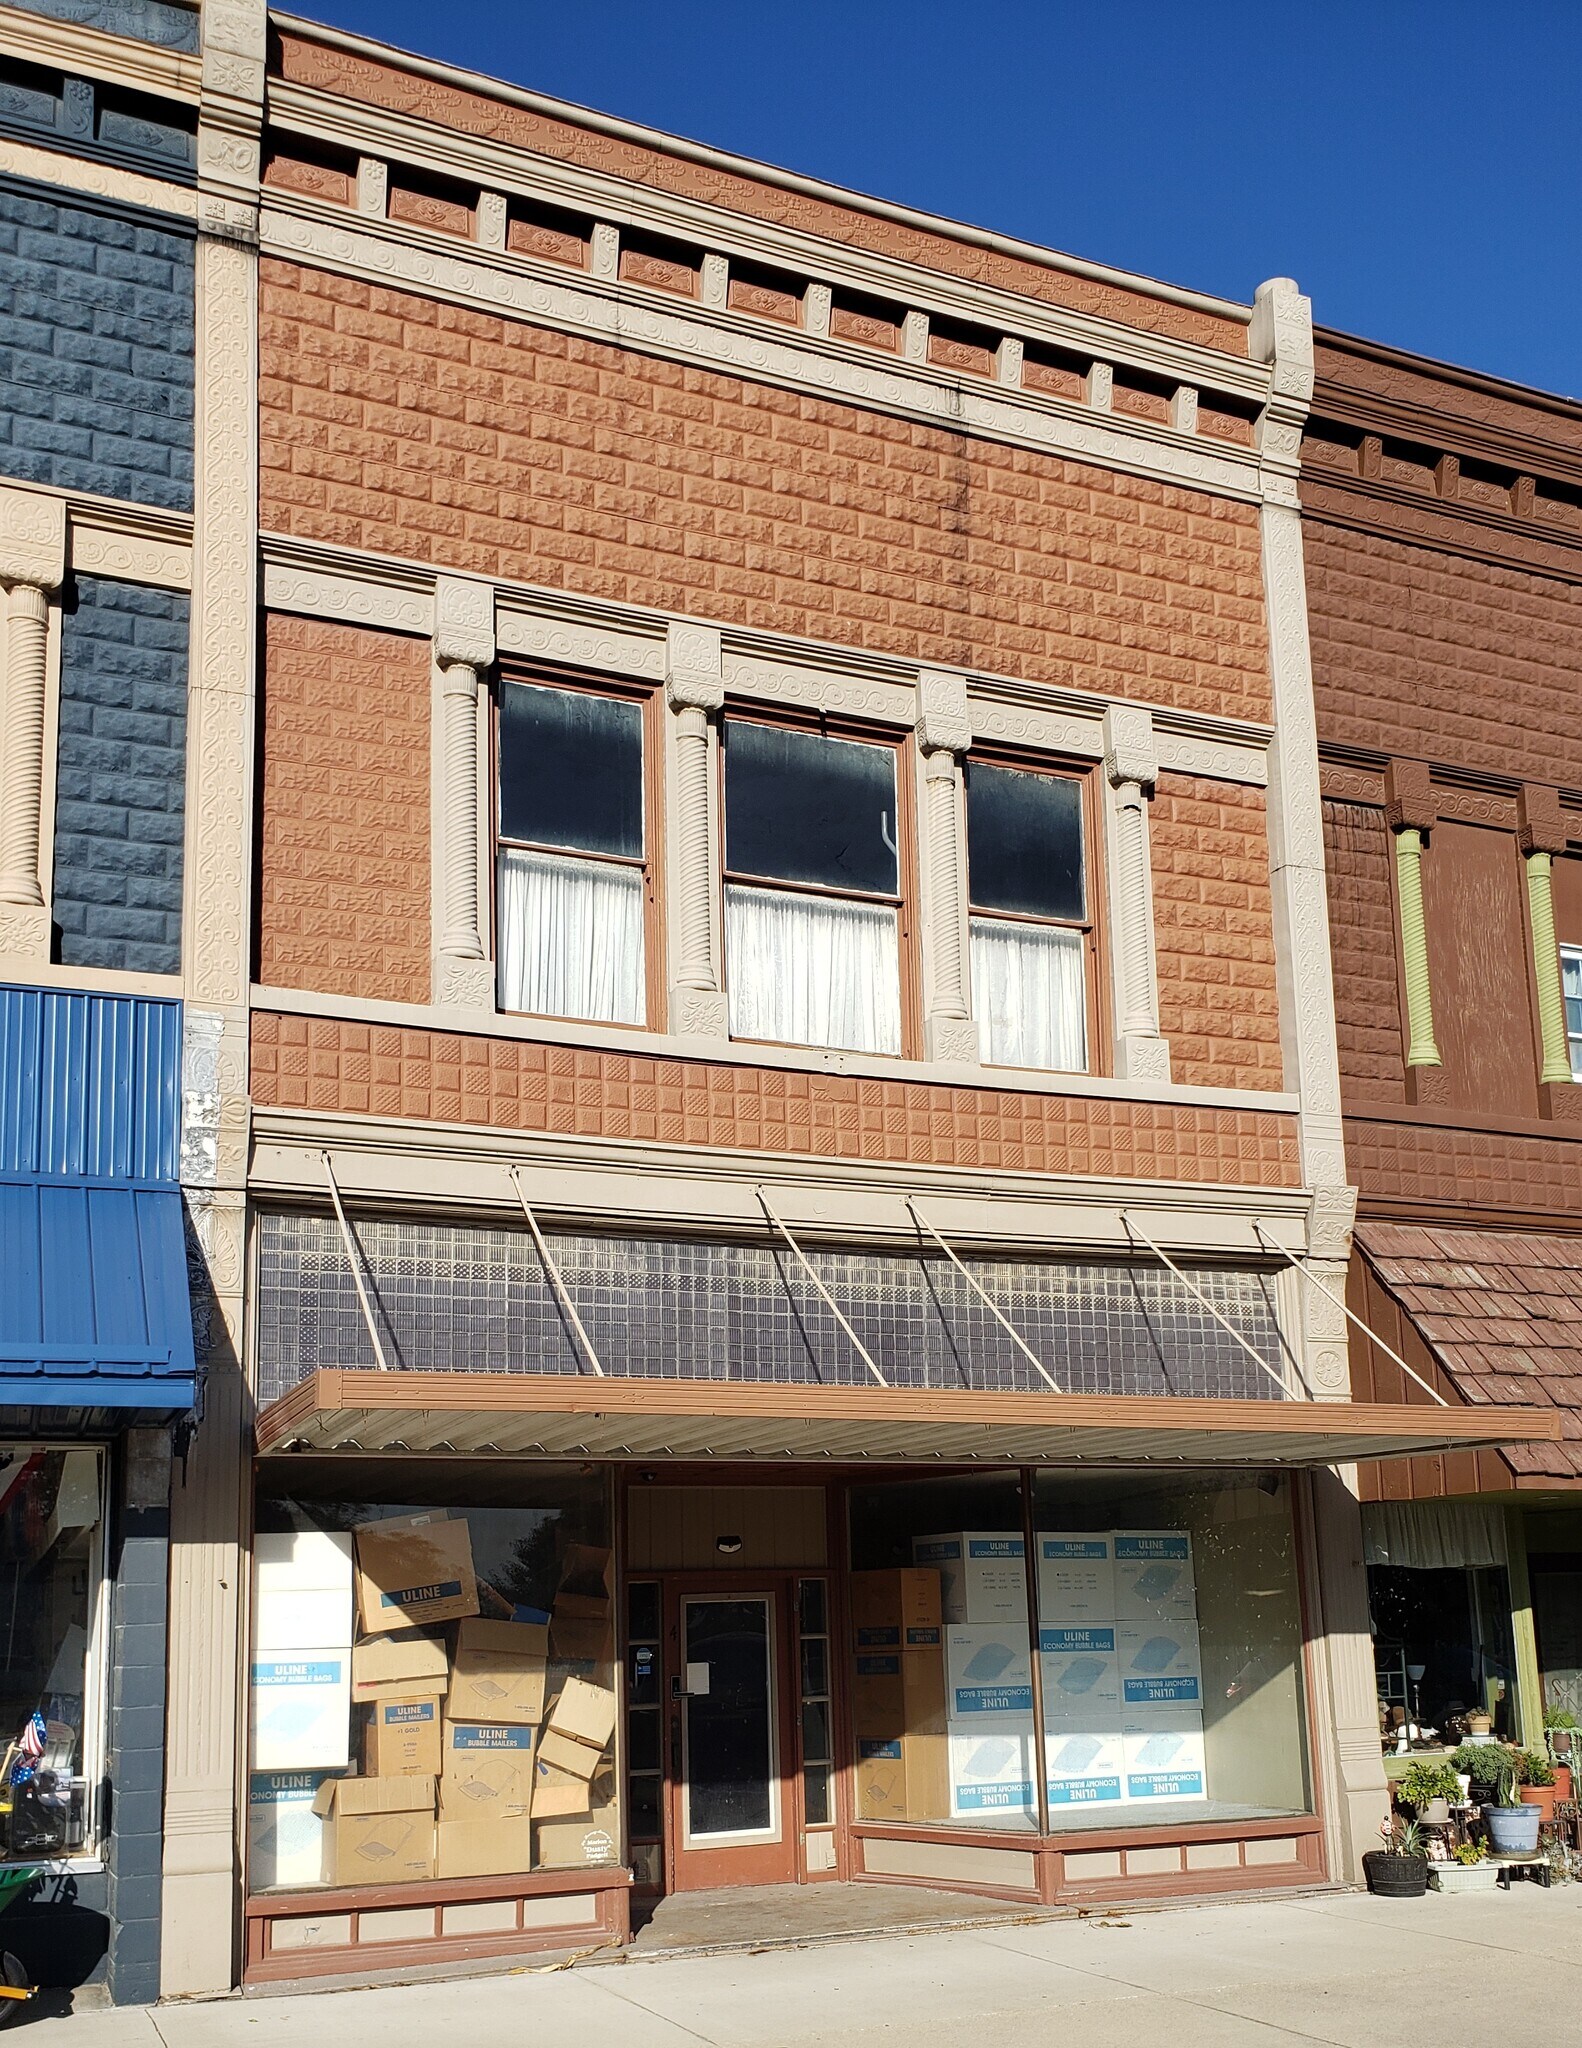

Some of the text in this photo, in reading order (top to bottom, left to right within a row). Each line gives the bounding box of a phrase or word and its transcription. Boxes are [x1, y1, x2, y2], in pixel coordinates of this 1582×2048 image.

[989, 1542, 1010, 1550] ULINE
[1064, 1543, 1086, 1551] ULINE
[1138, 1540, 1164, 1549] ULINE
[1117, 1549, 1148, 1557] ECONOMY
[1169, 1550, 1185, 1558] BAGS
[402, 1586, 441, 1602] ULINE
[1064, 1631, 1090, 1641] ULINE
[1043, 1642, 1074, 1650] ECONOMY
[1075, 1641, 1094, 1649] BUBBLE
[274, 1664, 308, 1675] ULINE
[254, 1675, 288, 1683] CONOMY
[313, 1674, 333, 1682] BAGS
[1165, 1679, 1195, 1687] ECONOMY
[1144, 1680, 1163, 1688] BUBBLE
[959, 1690, 976, 1698] BAGS
[998, 1688, 1030, 1696] ECONOMY
[1149, 1688, 1175, 1698] ULINE
[981, 1698, 1009, 1708] ULINE
[397, 1705, 422, 1715] ULINE
[478, 1729, 509, 1739] ULINE
[467, 1739, 518, 1747] BUBBLE MAILERS
[271, 1775, 312, 1789] ULINE
[1130, 1773, 1199, 1784] ECONOMY BUBBLE BAGS
[959, 1783, 1030, 1795] ECONOMY BUBBLE BAGS
[1048, 1778, 1117, 1790] ECONOMY BUBBLE BAGS
[1152, 1782, 1180, 1793] ULINE
[250, 1789, 317, 1800] ONOMY BUBBLE
[981, 1793, 1009, 1805] ULINE
[1069, 1788, 1097, 1800] ULINE
